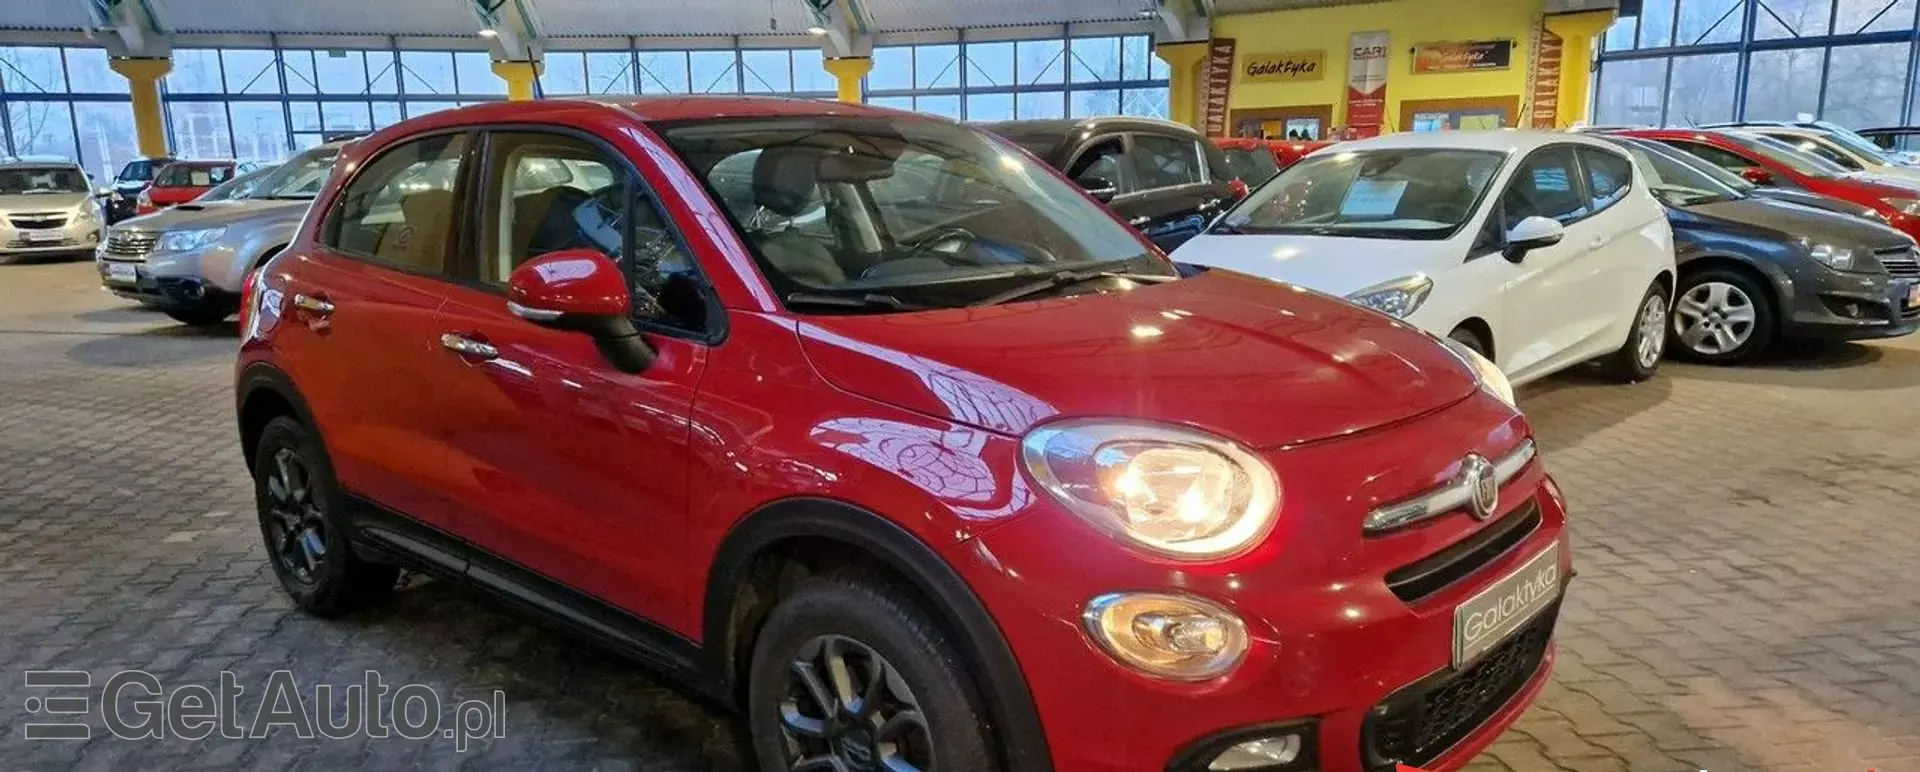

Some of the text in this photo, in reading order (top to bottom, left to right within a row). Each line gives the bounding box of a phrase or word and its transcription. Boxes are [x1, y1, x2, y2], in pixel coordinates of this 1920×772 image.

[1207, 45, 1232, 132] GALAKTYKA
[1246, 59, 1316, 77] Galaktyka
[1463, 565, 1557, 641] Galaktyka
